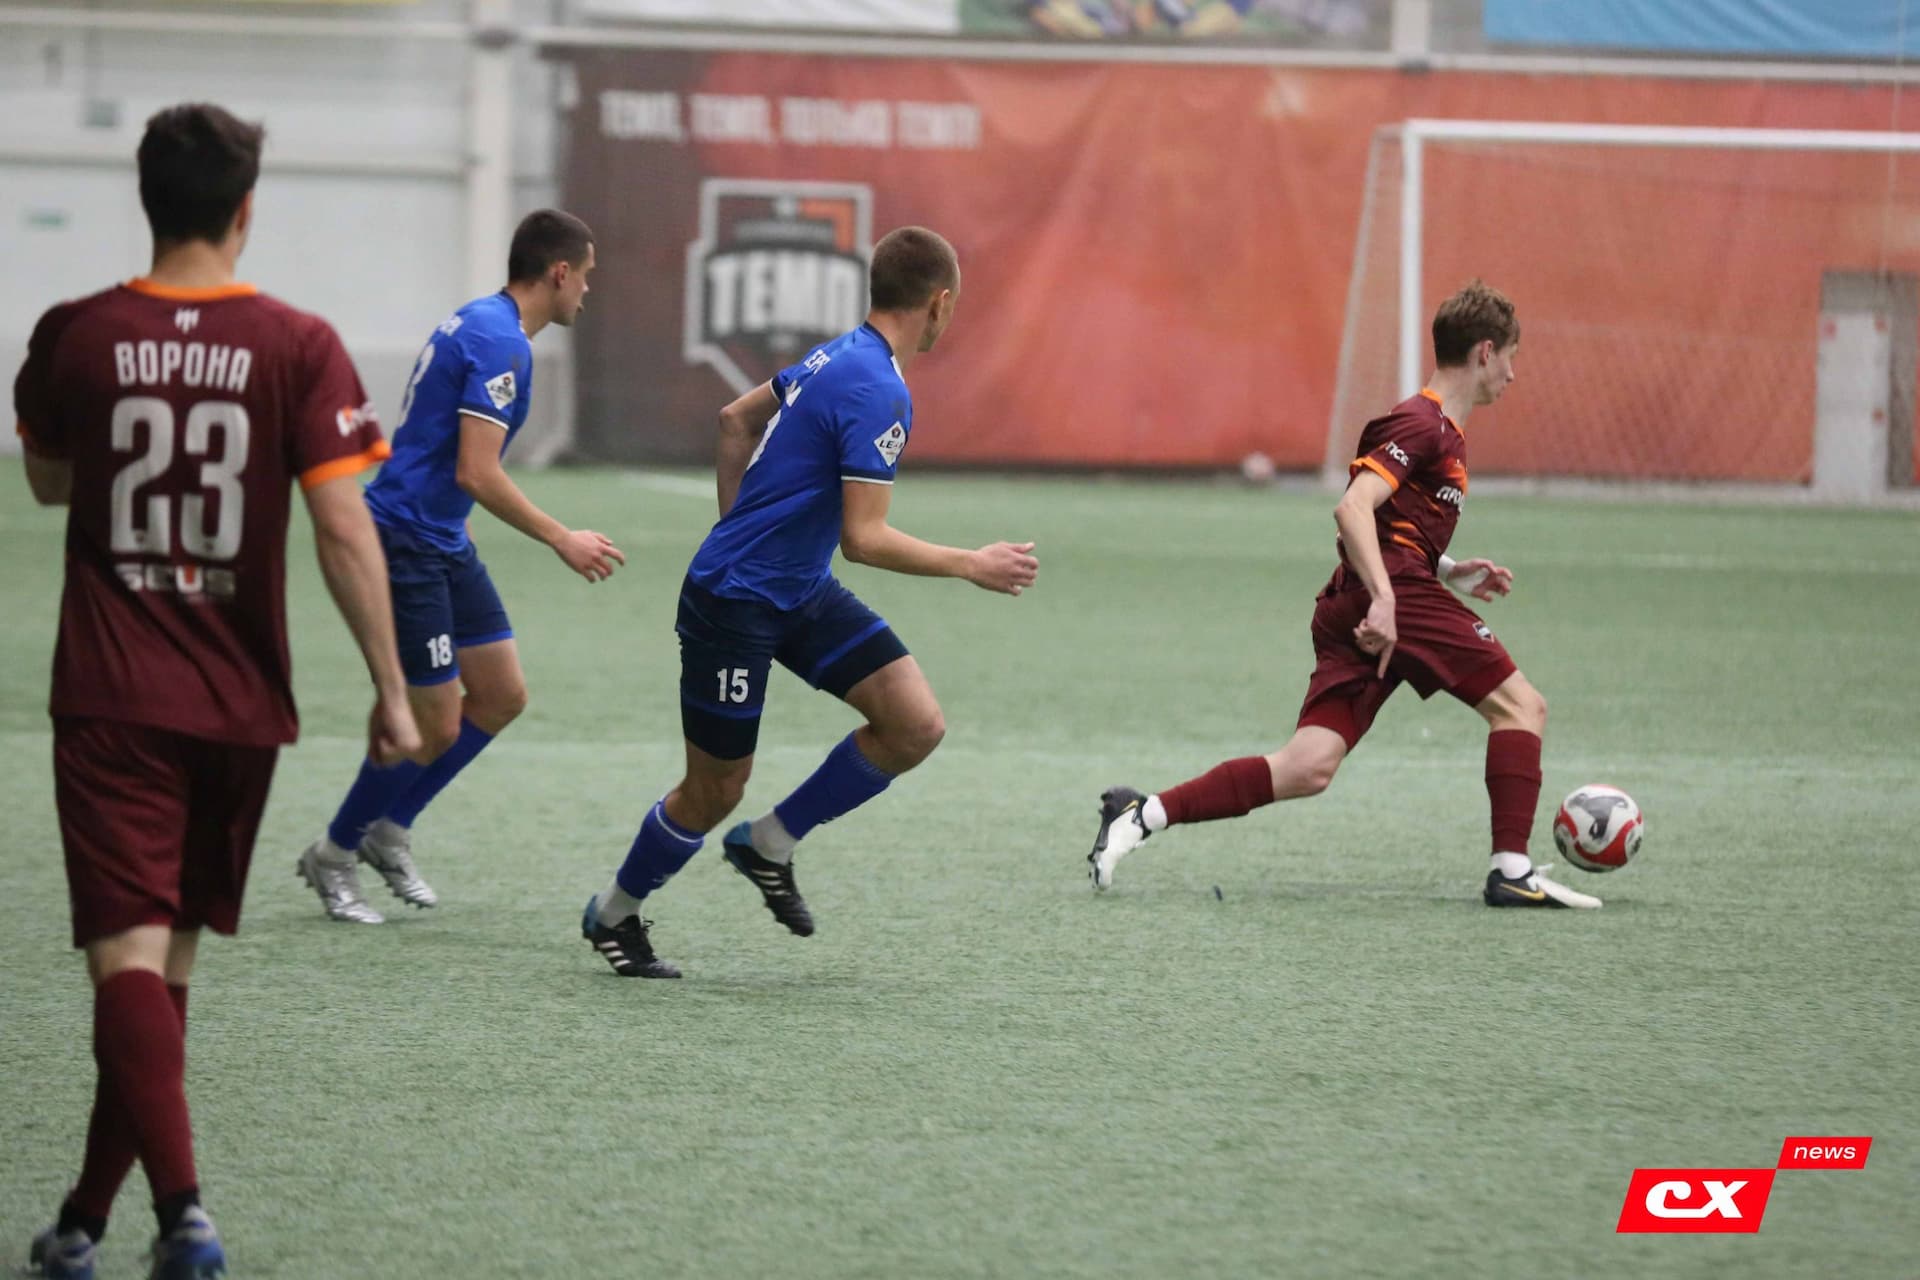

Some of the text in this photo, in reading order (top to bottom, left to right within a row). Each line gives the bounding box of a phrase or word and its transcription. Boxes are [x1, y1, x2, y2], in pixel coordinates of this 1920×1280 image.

[709, 250, 862, 335] ТЕМП
[114, 340, 253, 393] ВОРОНА
[110, 396, 250, 561] 23
[426, 634, 452, 668] 18
[717, 668, 749, 703] 15
